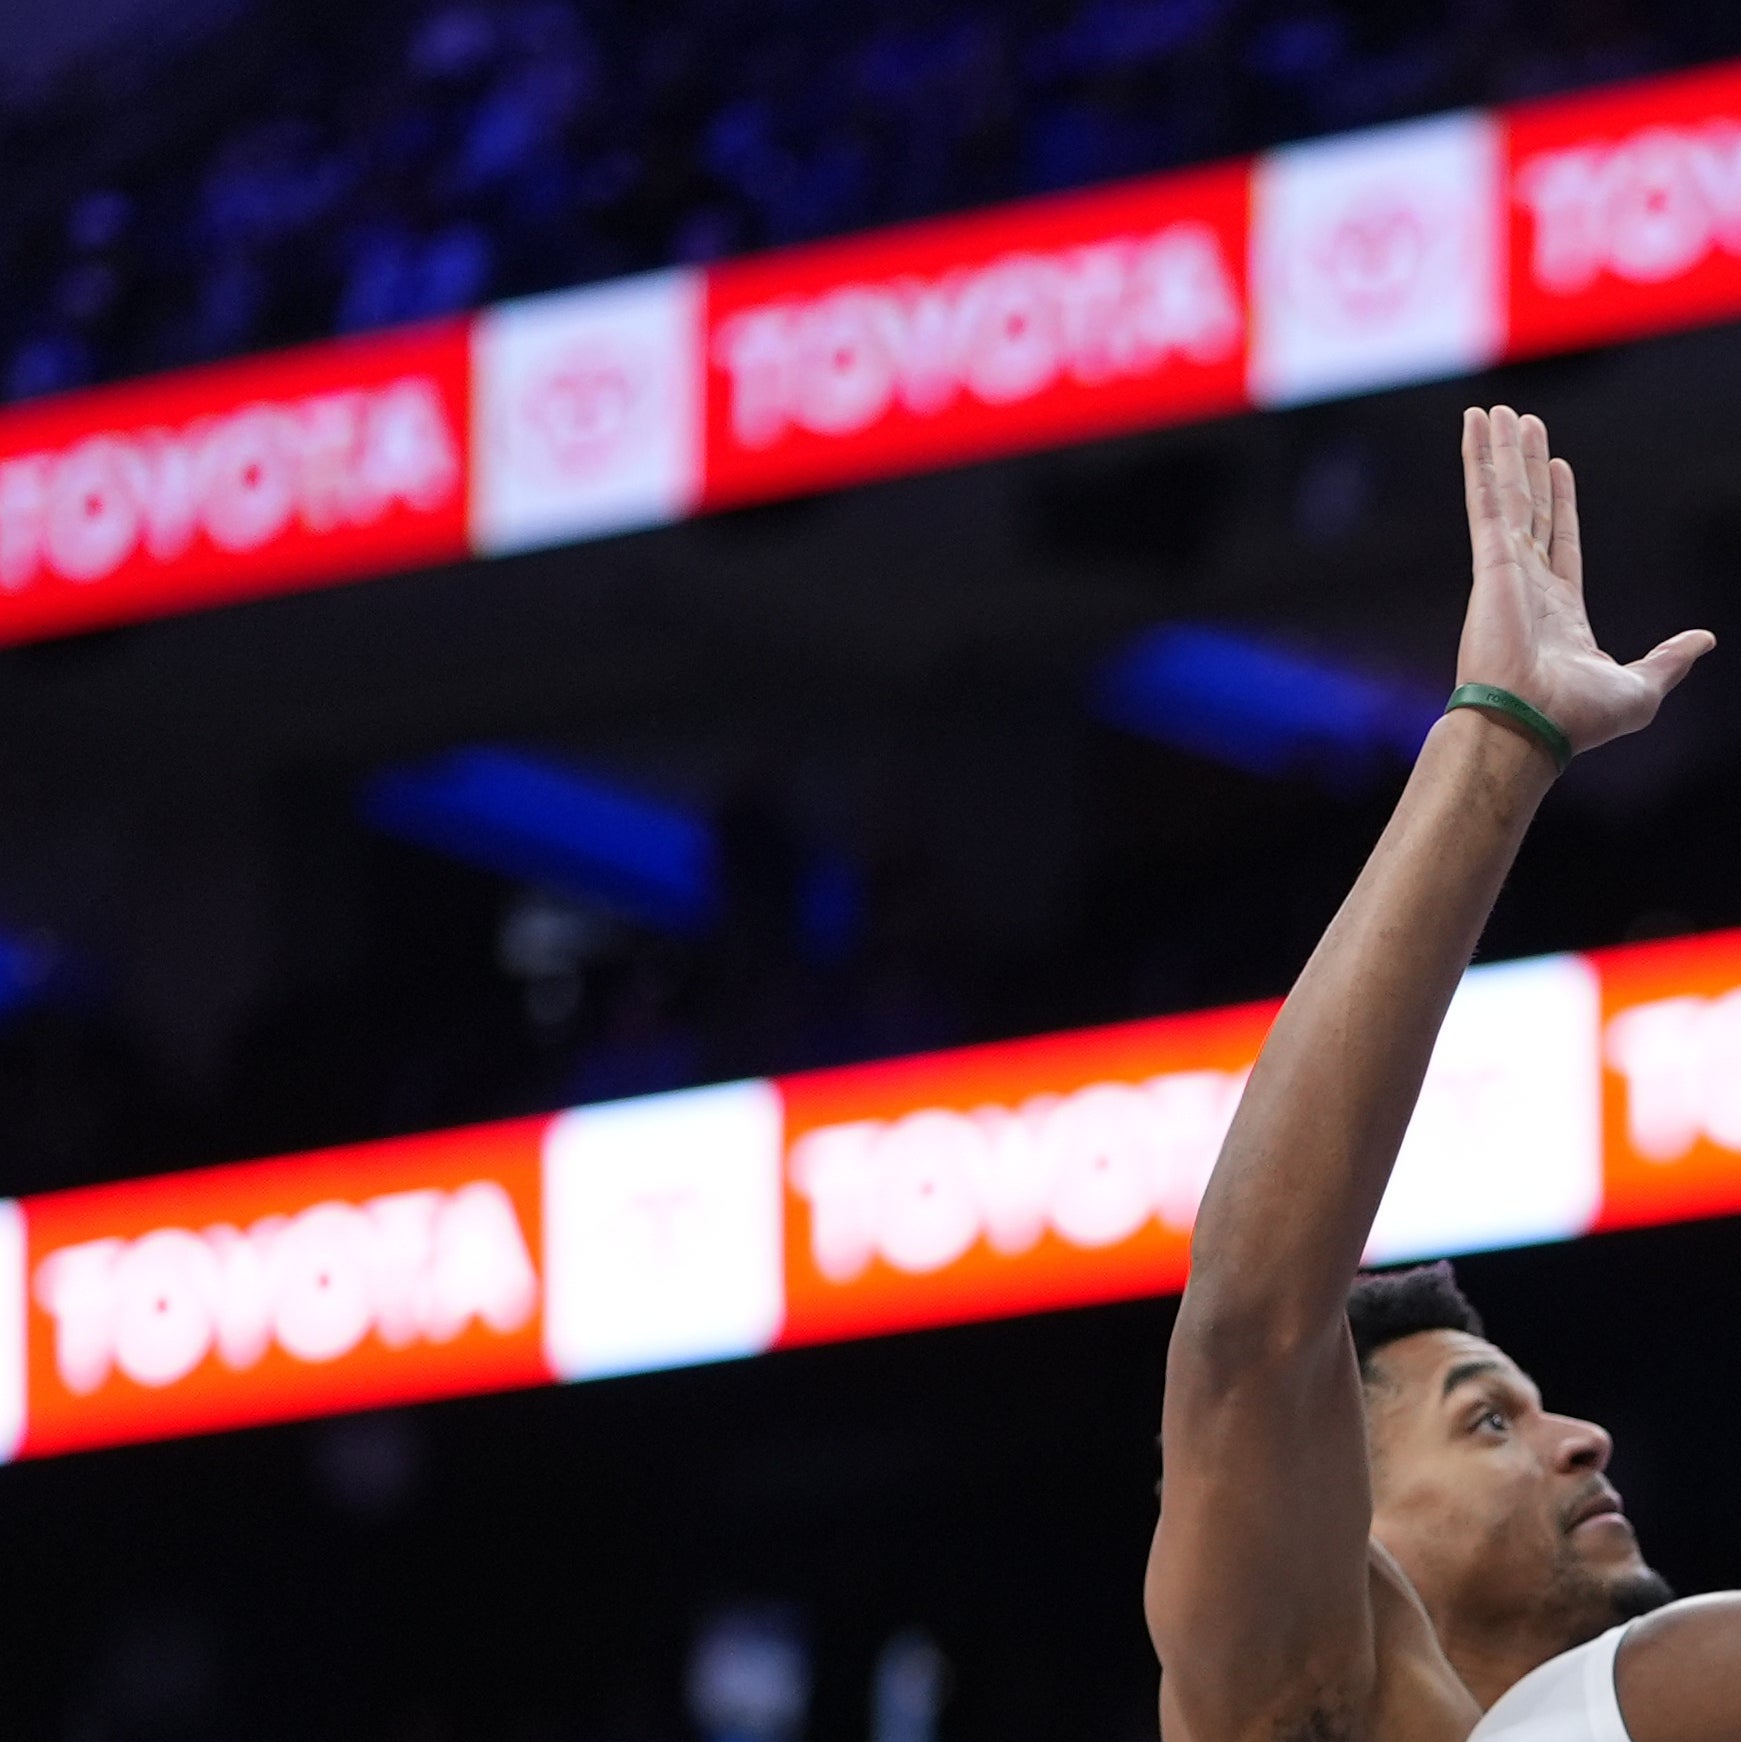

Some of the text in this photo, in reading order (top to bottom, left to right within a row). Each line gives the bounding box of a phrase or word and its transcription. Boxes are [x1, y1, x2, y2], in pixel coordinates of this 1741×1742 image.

[715, 223, 1240, 448] TOYOTA
[787, 1063, 1254, 1284] TOYOT
[33, 1180, 537, 1395] TOYOTA
